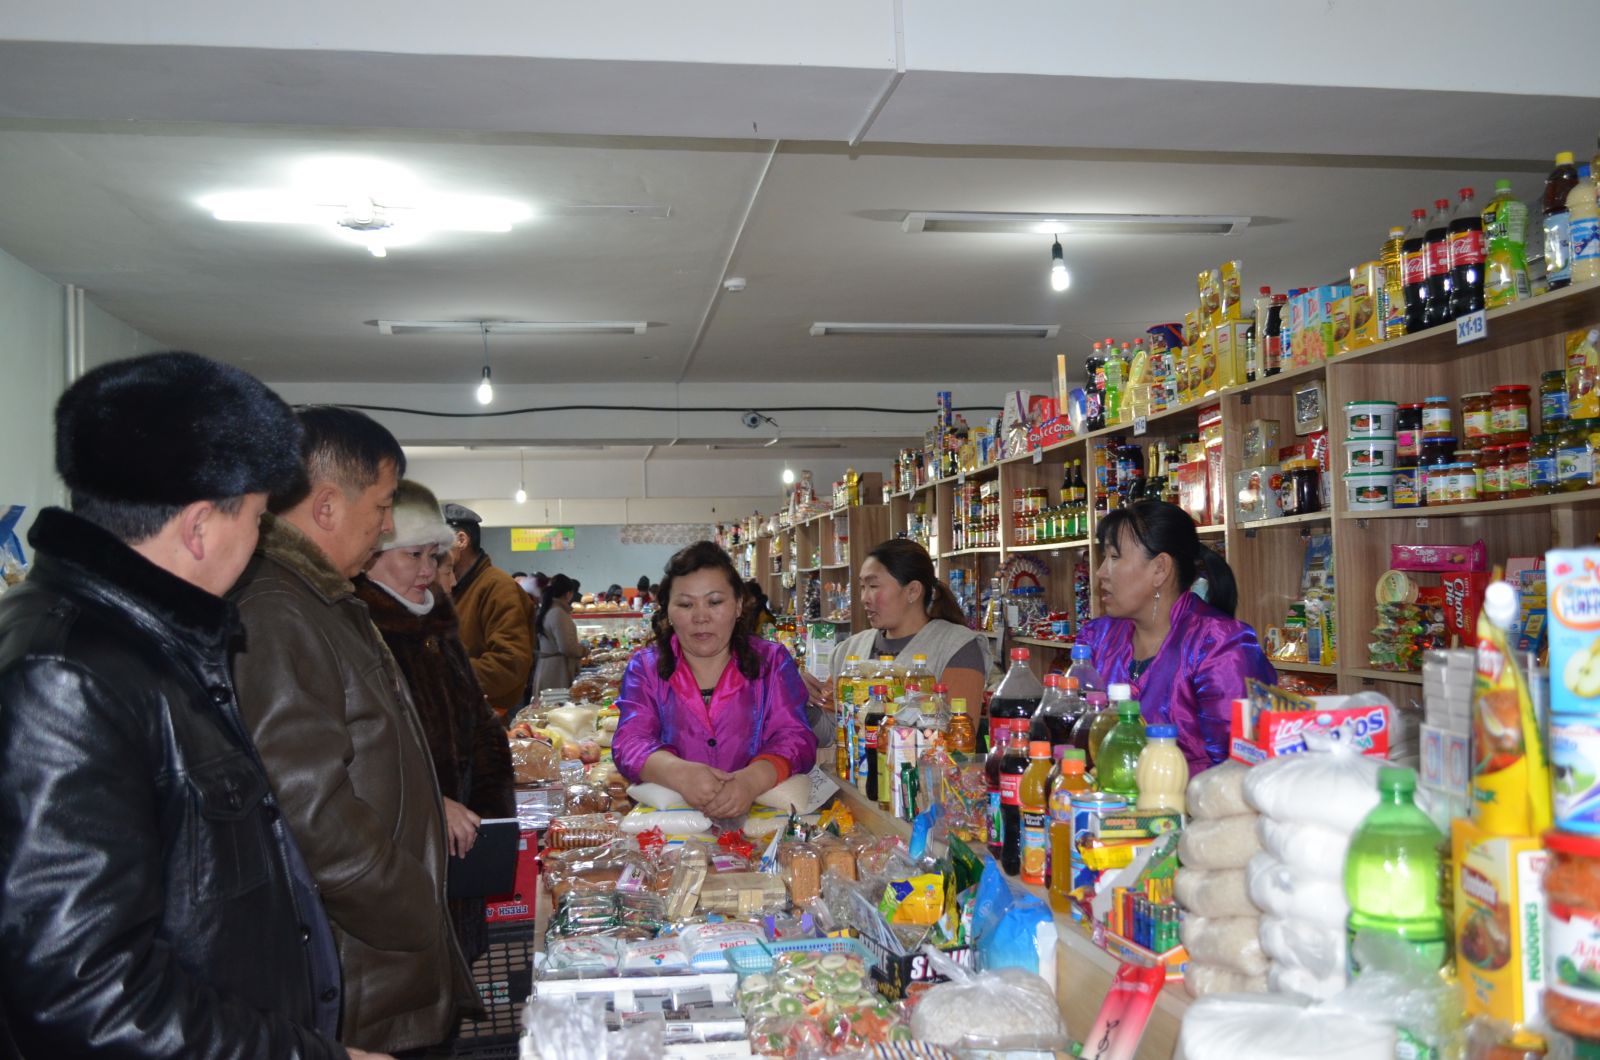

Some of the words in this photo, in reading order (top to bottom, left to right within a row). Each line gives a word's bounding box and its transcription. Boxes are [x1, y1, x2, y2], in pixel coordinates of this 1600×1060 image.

[1443, 579, 1456, 606] Pie
[1453, 578, 1465, 628] Choco
[498, 905, 528, 916] FRESH
[719, 940, 748, 950] NaCl
